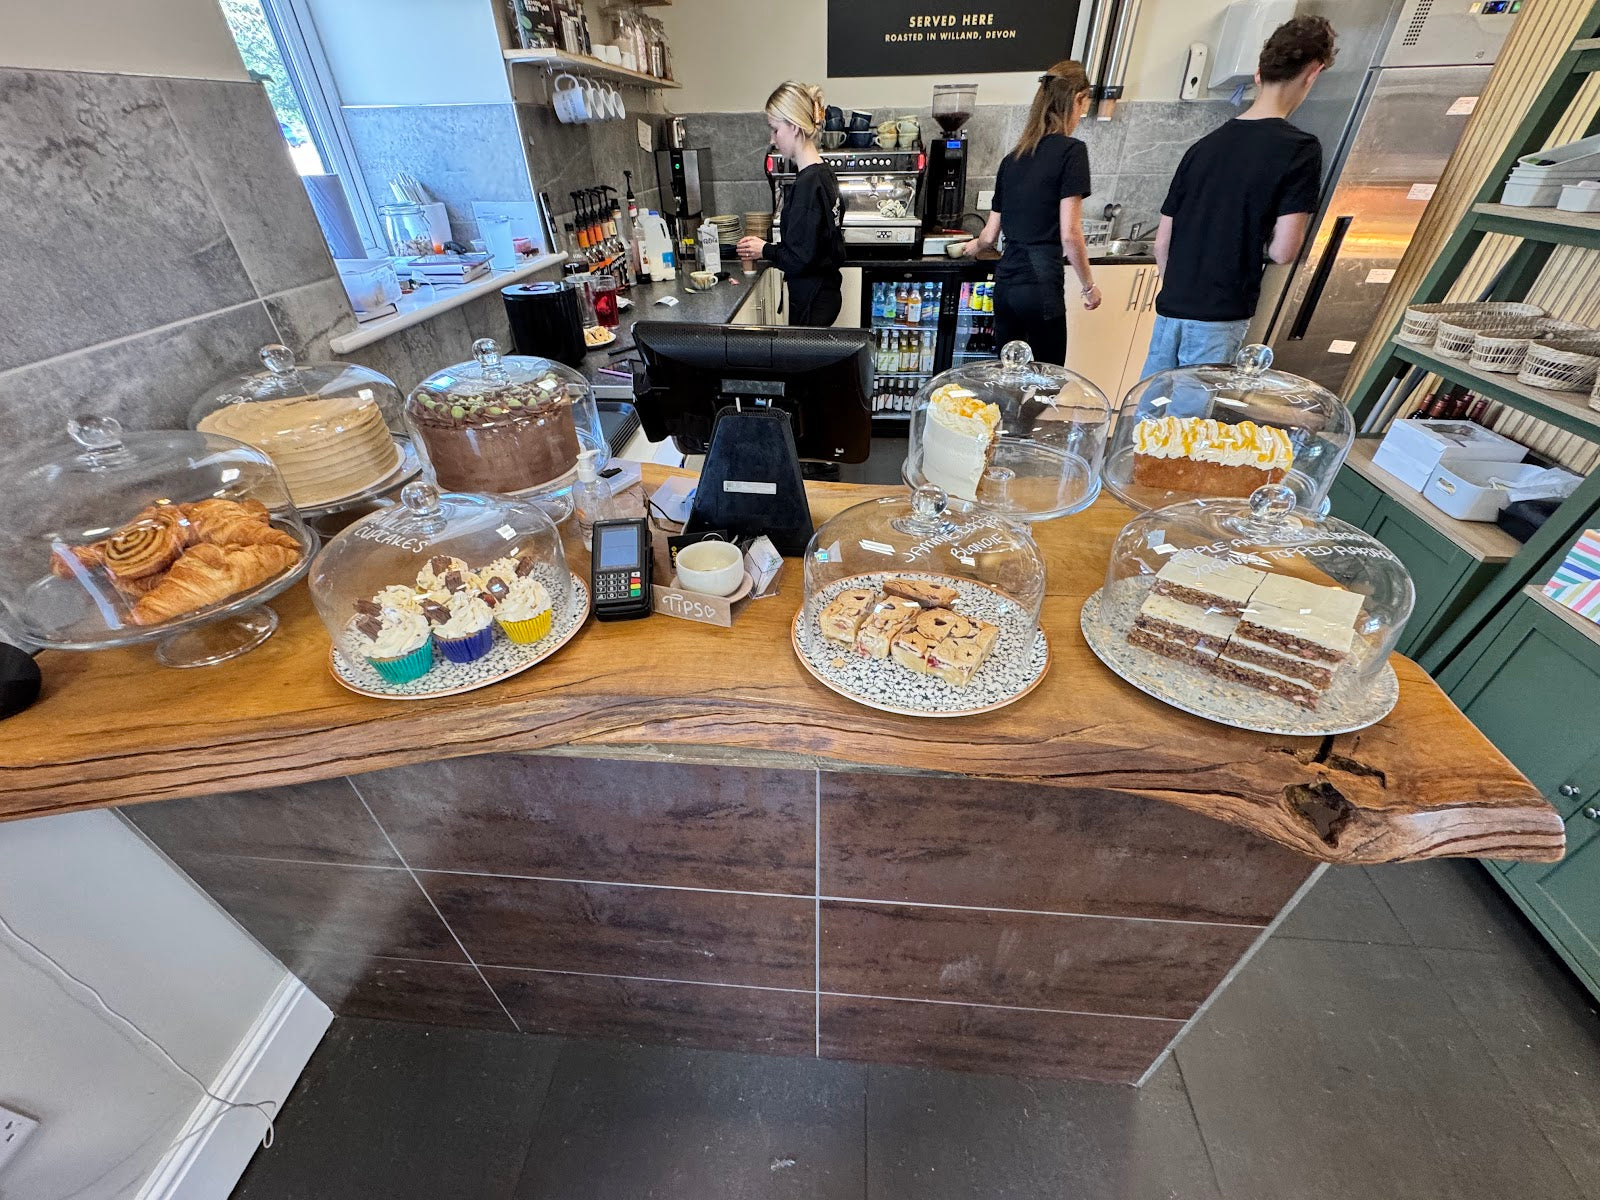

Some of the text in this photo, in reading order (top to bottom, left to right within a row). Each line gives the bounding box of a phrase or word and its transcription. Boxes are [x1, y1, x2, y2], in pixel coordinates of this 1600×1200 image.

[909, 13, 994, 28] SERVED HERE
[885, 30, 1017, 42] ROASTED IN WILLAND, DEVON
[354, 524, 428, 553] CUPCAKES
[1262, 546, 1333, 560] TOPPED
